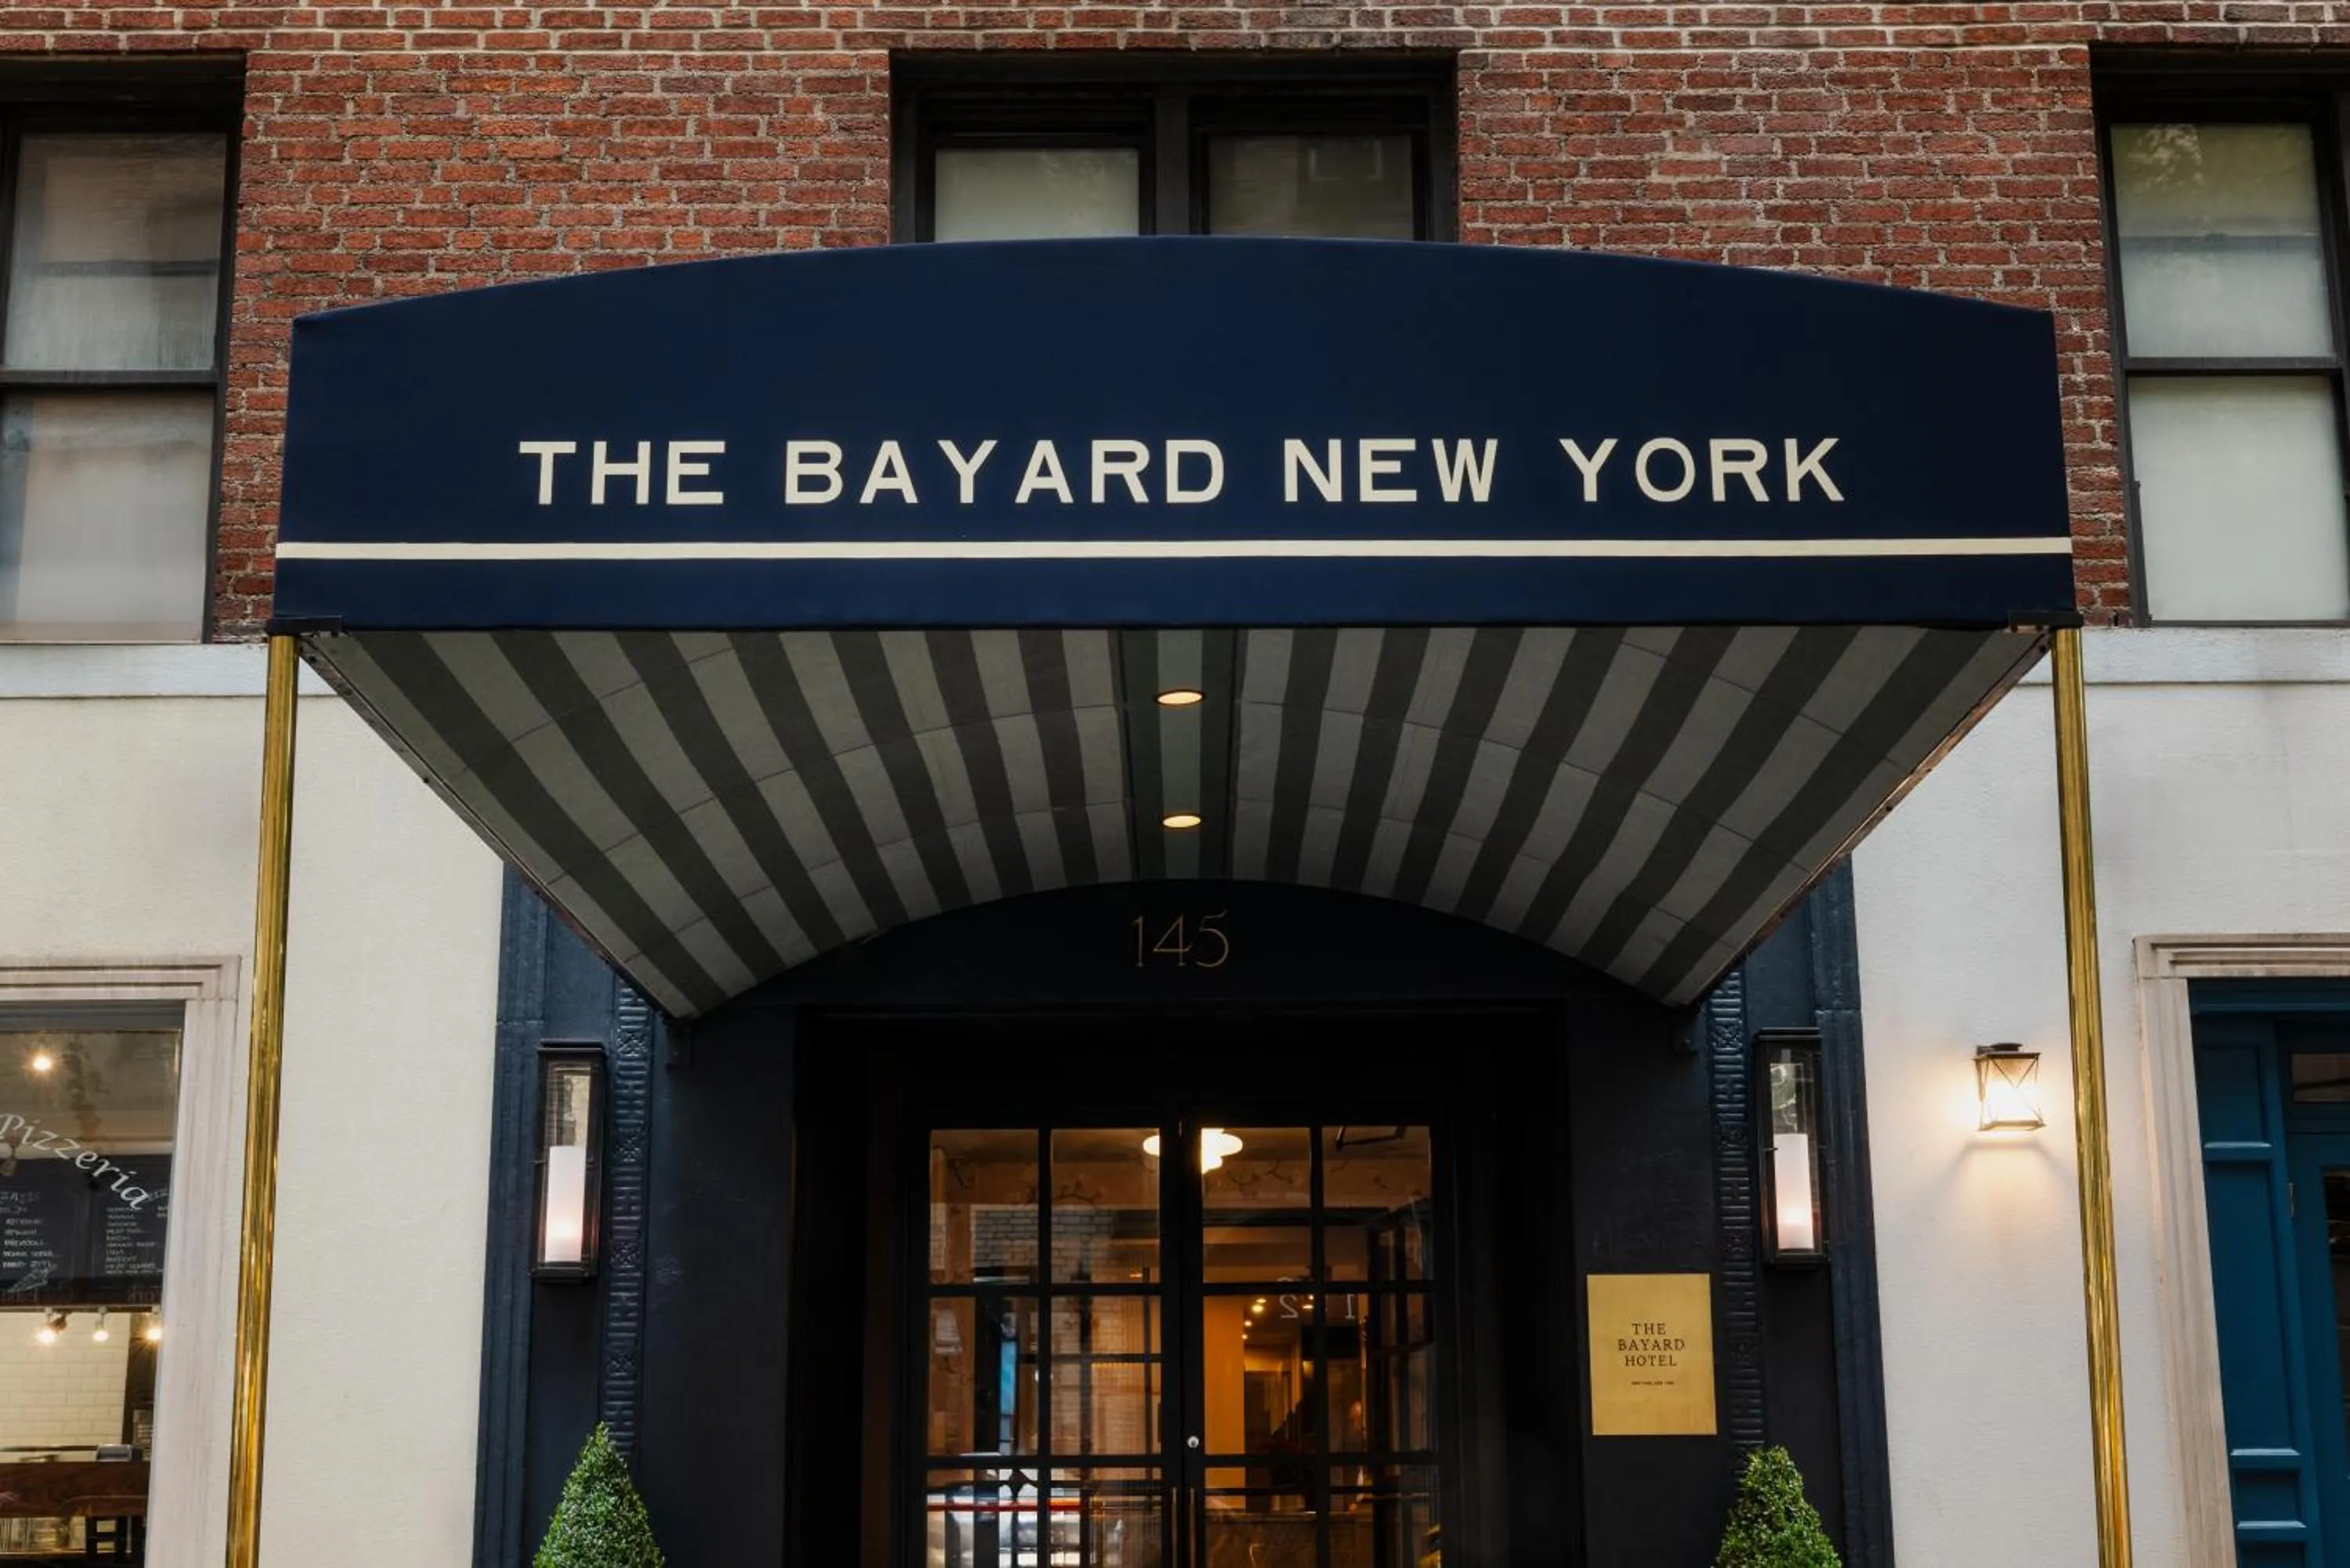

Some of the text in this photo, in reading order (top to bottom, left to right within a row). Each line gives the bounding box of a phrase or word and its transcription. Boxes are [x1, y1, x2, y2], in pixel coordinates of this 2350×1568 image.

[519, 437, 1845, 505] THE BAYARD NEW YORK
[1130, 909, 1229, 968] 145
[0, 1113, 150, 1211] Pizzeria
[1618, 1339, 1685, 1351] BAYARD
[1631, 1323, 1666, 1335] THE
[1625, 1355, 1677, 1367] HOTEL
